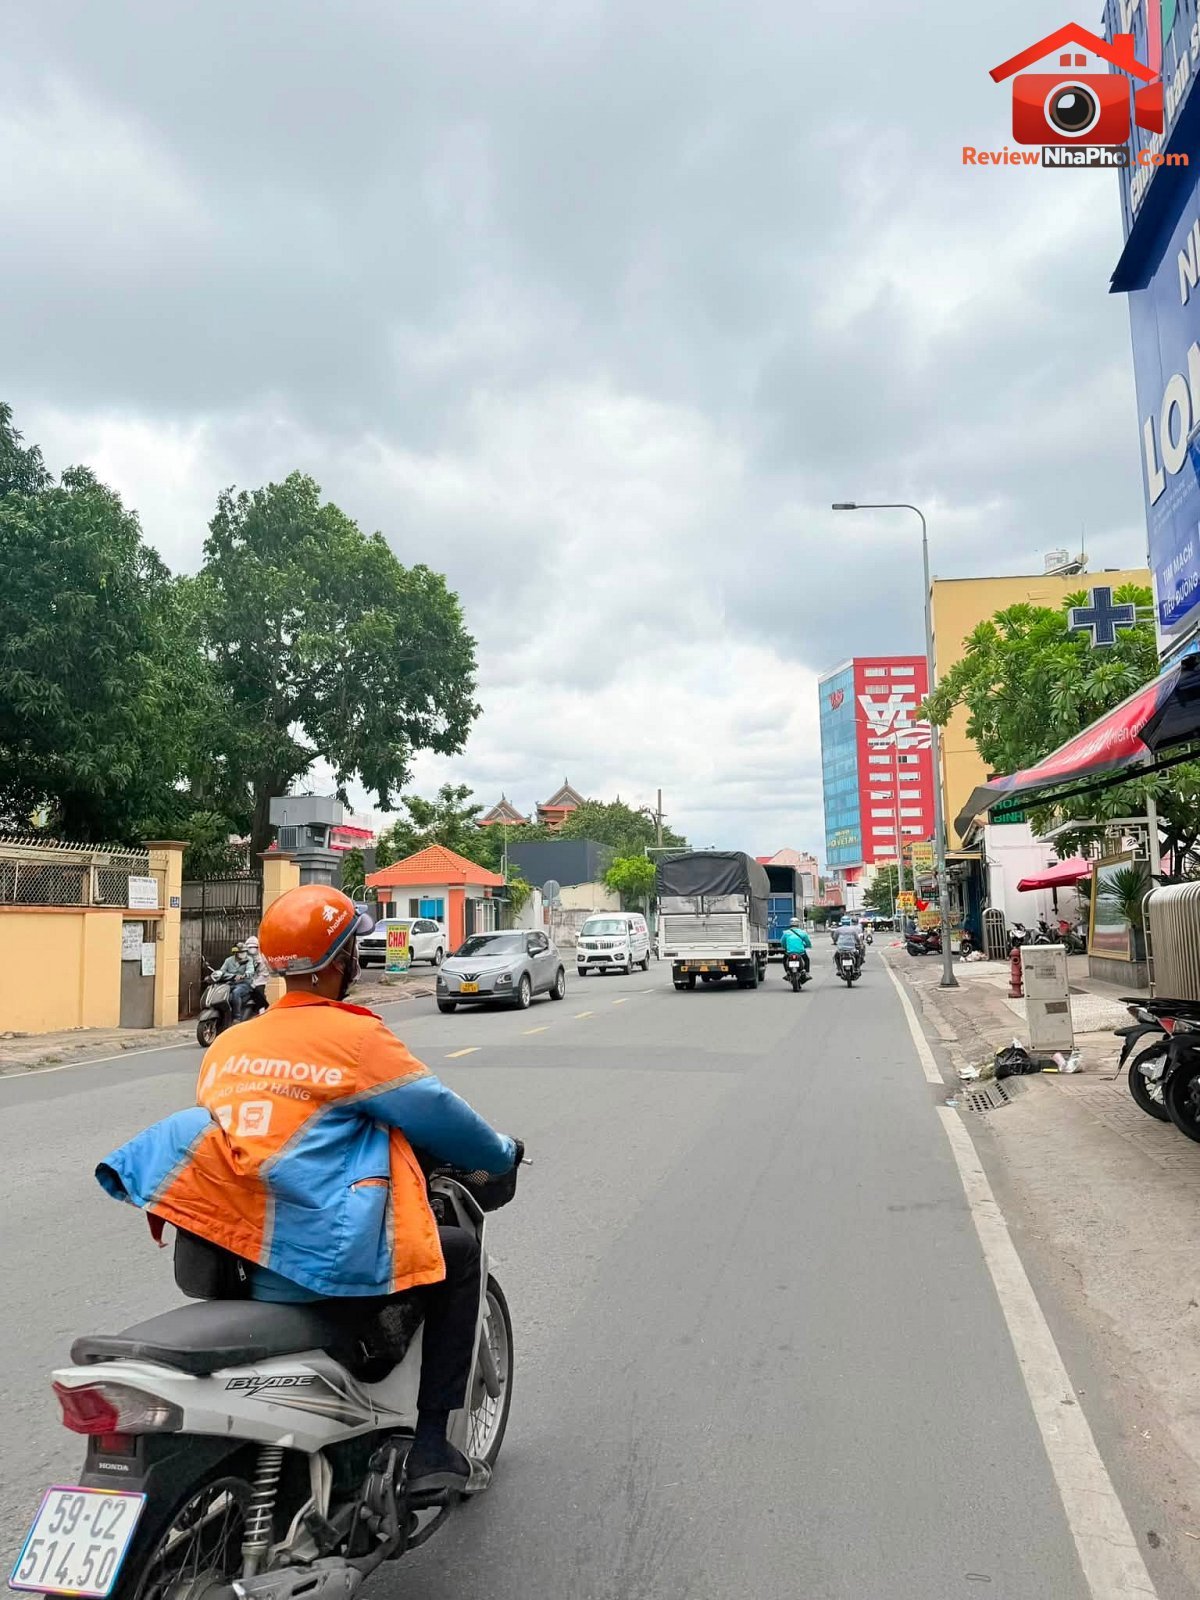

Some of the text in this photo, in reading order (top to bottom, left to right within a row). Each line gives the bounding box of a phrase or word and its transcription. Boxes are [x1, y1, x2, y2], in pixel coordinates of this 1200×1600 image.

[225, 1375, 316, 1397] BLADE
[98, 1461, 129, 1472] HONDA
[19, 1538, 118, 1588] 514.50
